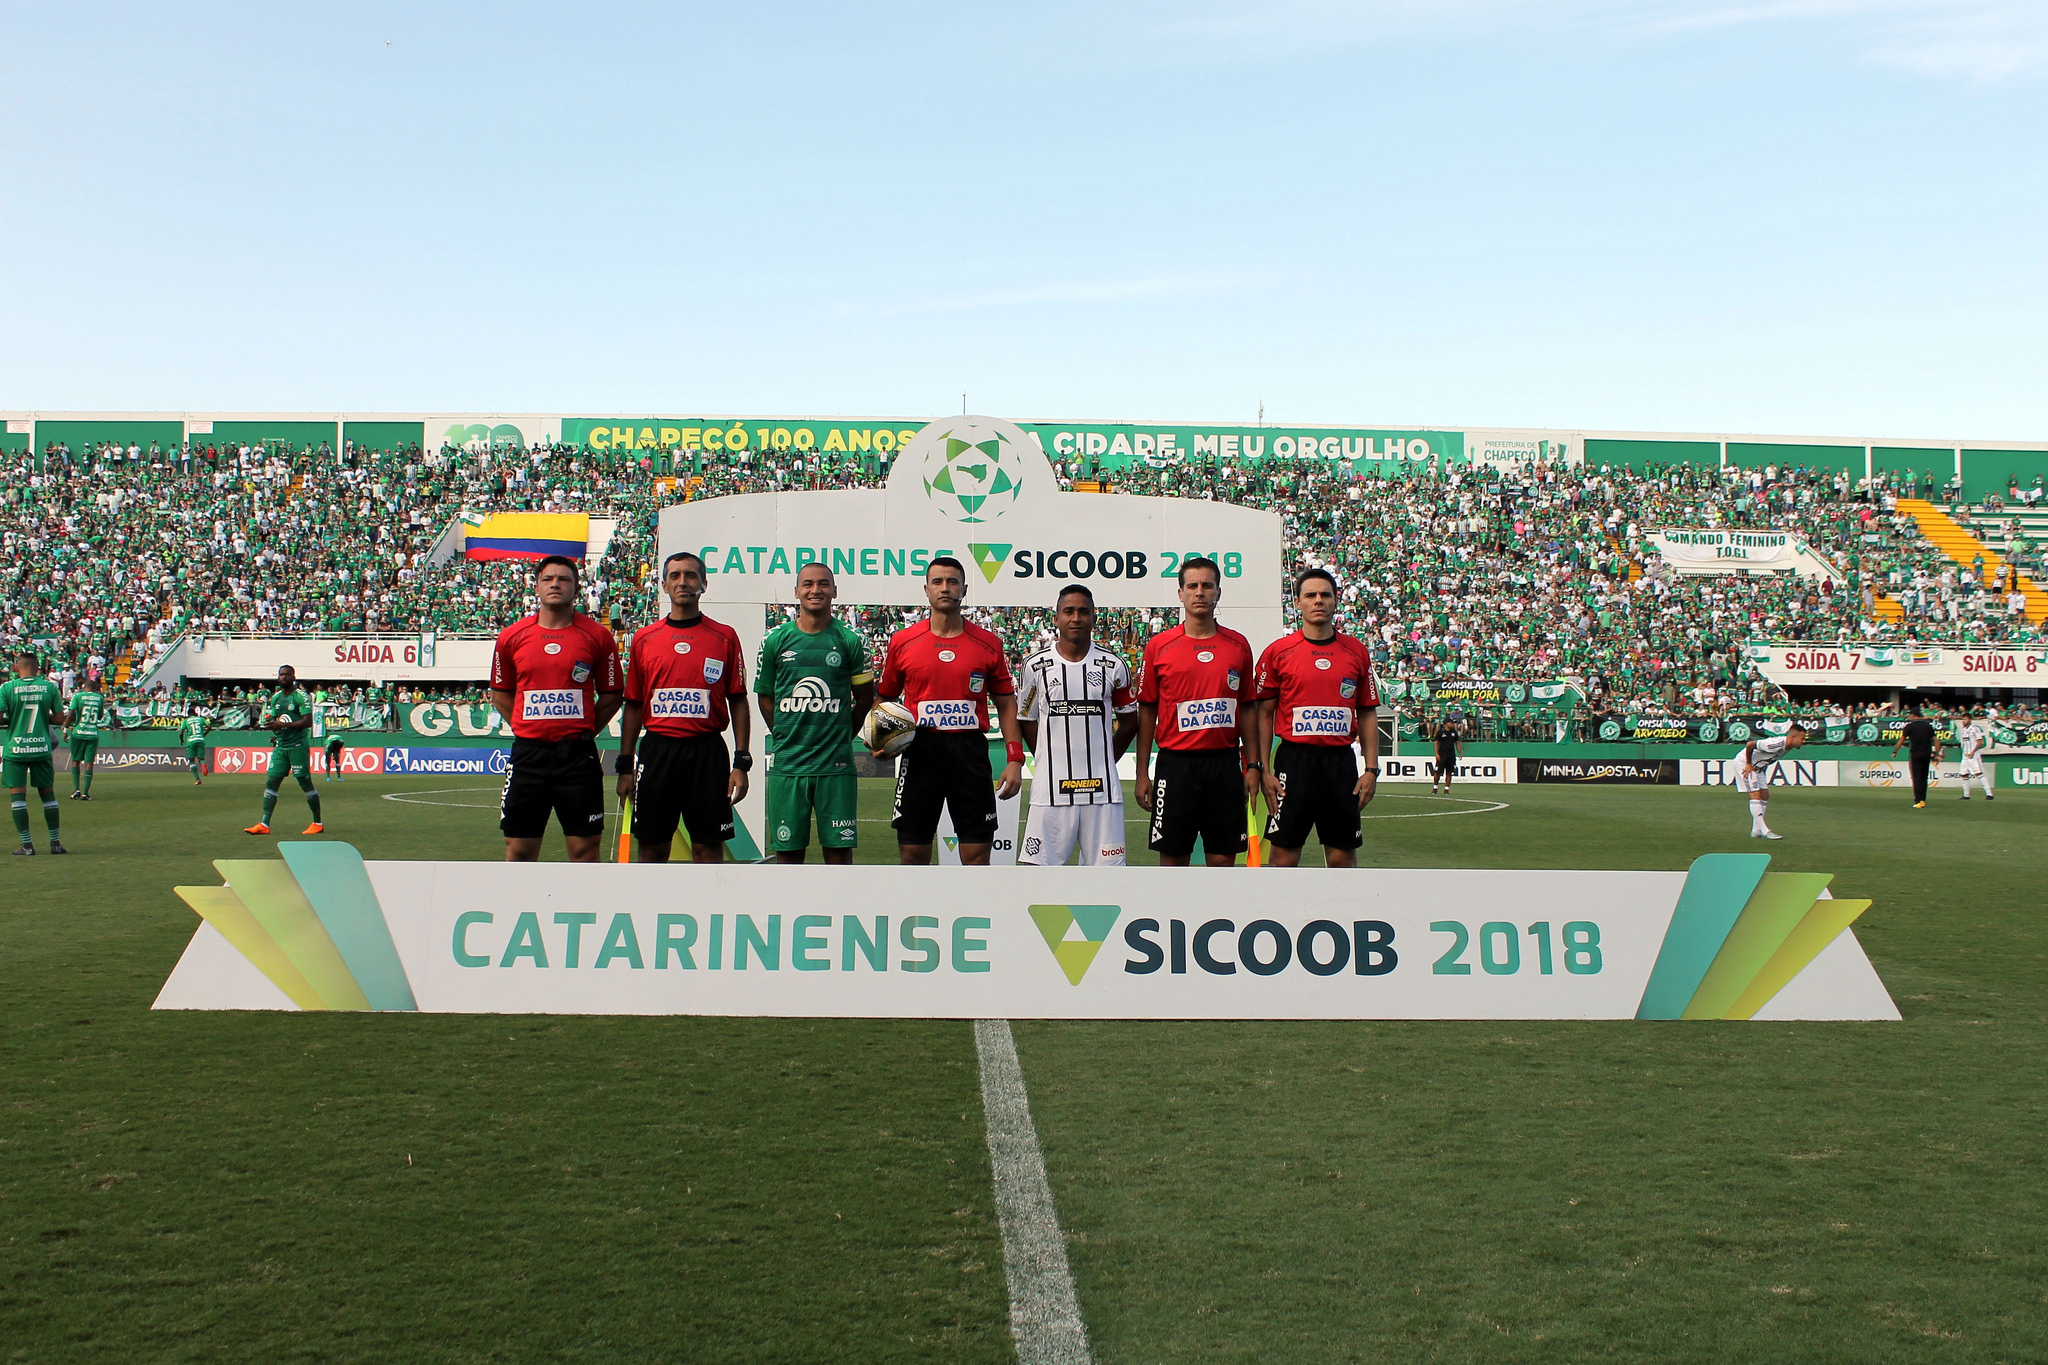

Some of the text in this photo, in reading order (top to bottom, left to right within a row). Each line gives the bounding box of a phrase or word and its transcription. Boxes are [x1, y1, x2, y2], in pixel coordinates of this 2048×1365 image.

[589, 421, 747, 452] CHAPECÓ
[756, 428, 815, 451] 100
[1193, 435, 1266, 459] MEU
[1730, 534, 1785, 547] FEMININO
[1013, 550, 1148, 579] SICOOB
[335, 641, 416, 663] SAÍDA 6
[1785, 650, 1860, 670] SAÍDA 7
[1963, 651, 2037, 672] SAÍDA 8
[705, 667, 720, 676] FIFA
[1441, 680, 1494, 690] CONSULADO
[531, 693, 574, 704] CASAS
[658, 692, 700, 702] CASAS
[1435, 690, 1470, 700] CUNHA
[653, 704, 667, 714] DA
[779, 697, 841, 713] aurora
[925, 703, 970, 714] CASAS
[1050, 704, 1102, 714] NEXERA
[1187, 701, 1228, 714] CASAS
[81, 706, 98, 723] 55
[525, 706, 540, 716] DA
[1302, 709, 1344, 720] CASAS
[24, 704, 39, 733] 7
[918, 717, 937, 727] DA
[1181, 718, 1200, 728] DA
[190, 722, 200, 735] 15
[1295, 722, 1313, 732] DA
[1633, 728, 1687, 738] ARVOREDO
[12, 745, 48, 754] Unimed
[409, 759, 484, 773] ANGELONI
[1386, 761, 1415, 776] De
[1543, 765, 1584, 777] MINHA
[1860, 770, 1902, 779] SUPREMO
[894, 758, 909, 807] SICOOB
[1062, 779, 1101, 789] PIONEIRO
[1155, 779, 1167, 828] SICOOB
[452, 911, 1602, 976] CATARINENSE SICOOB 2018
